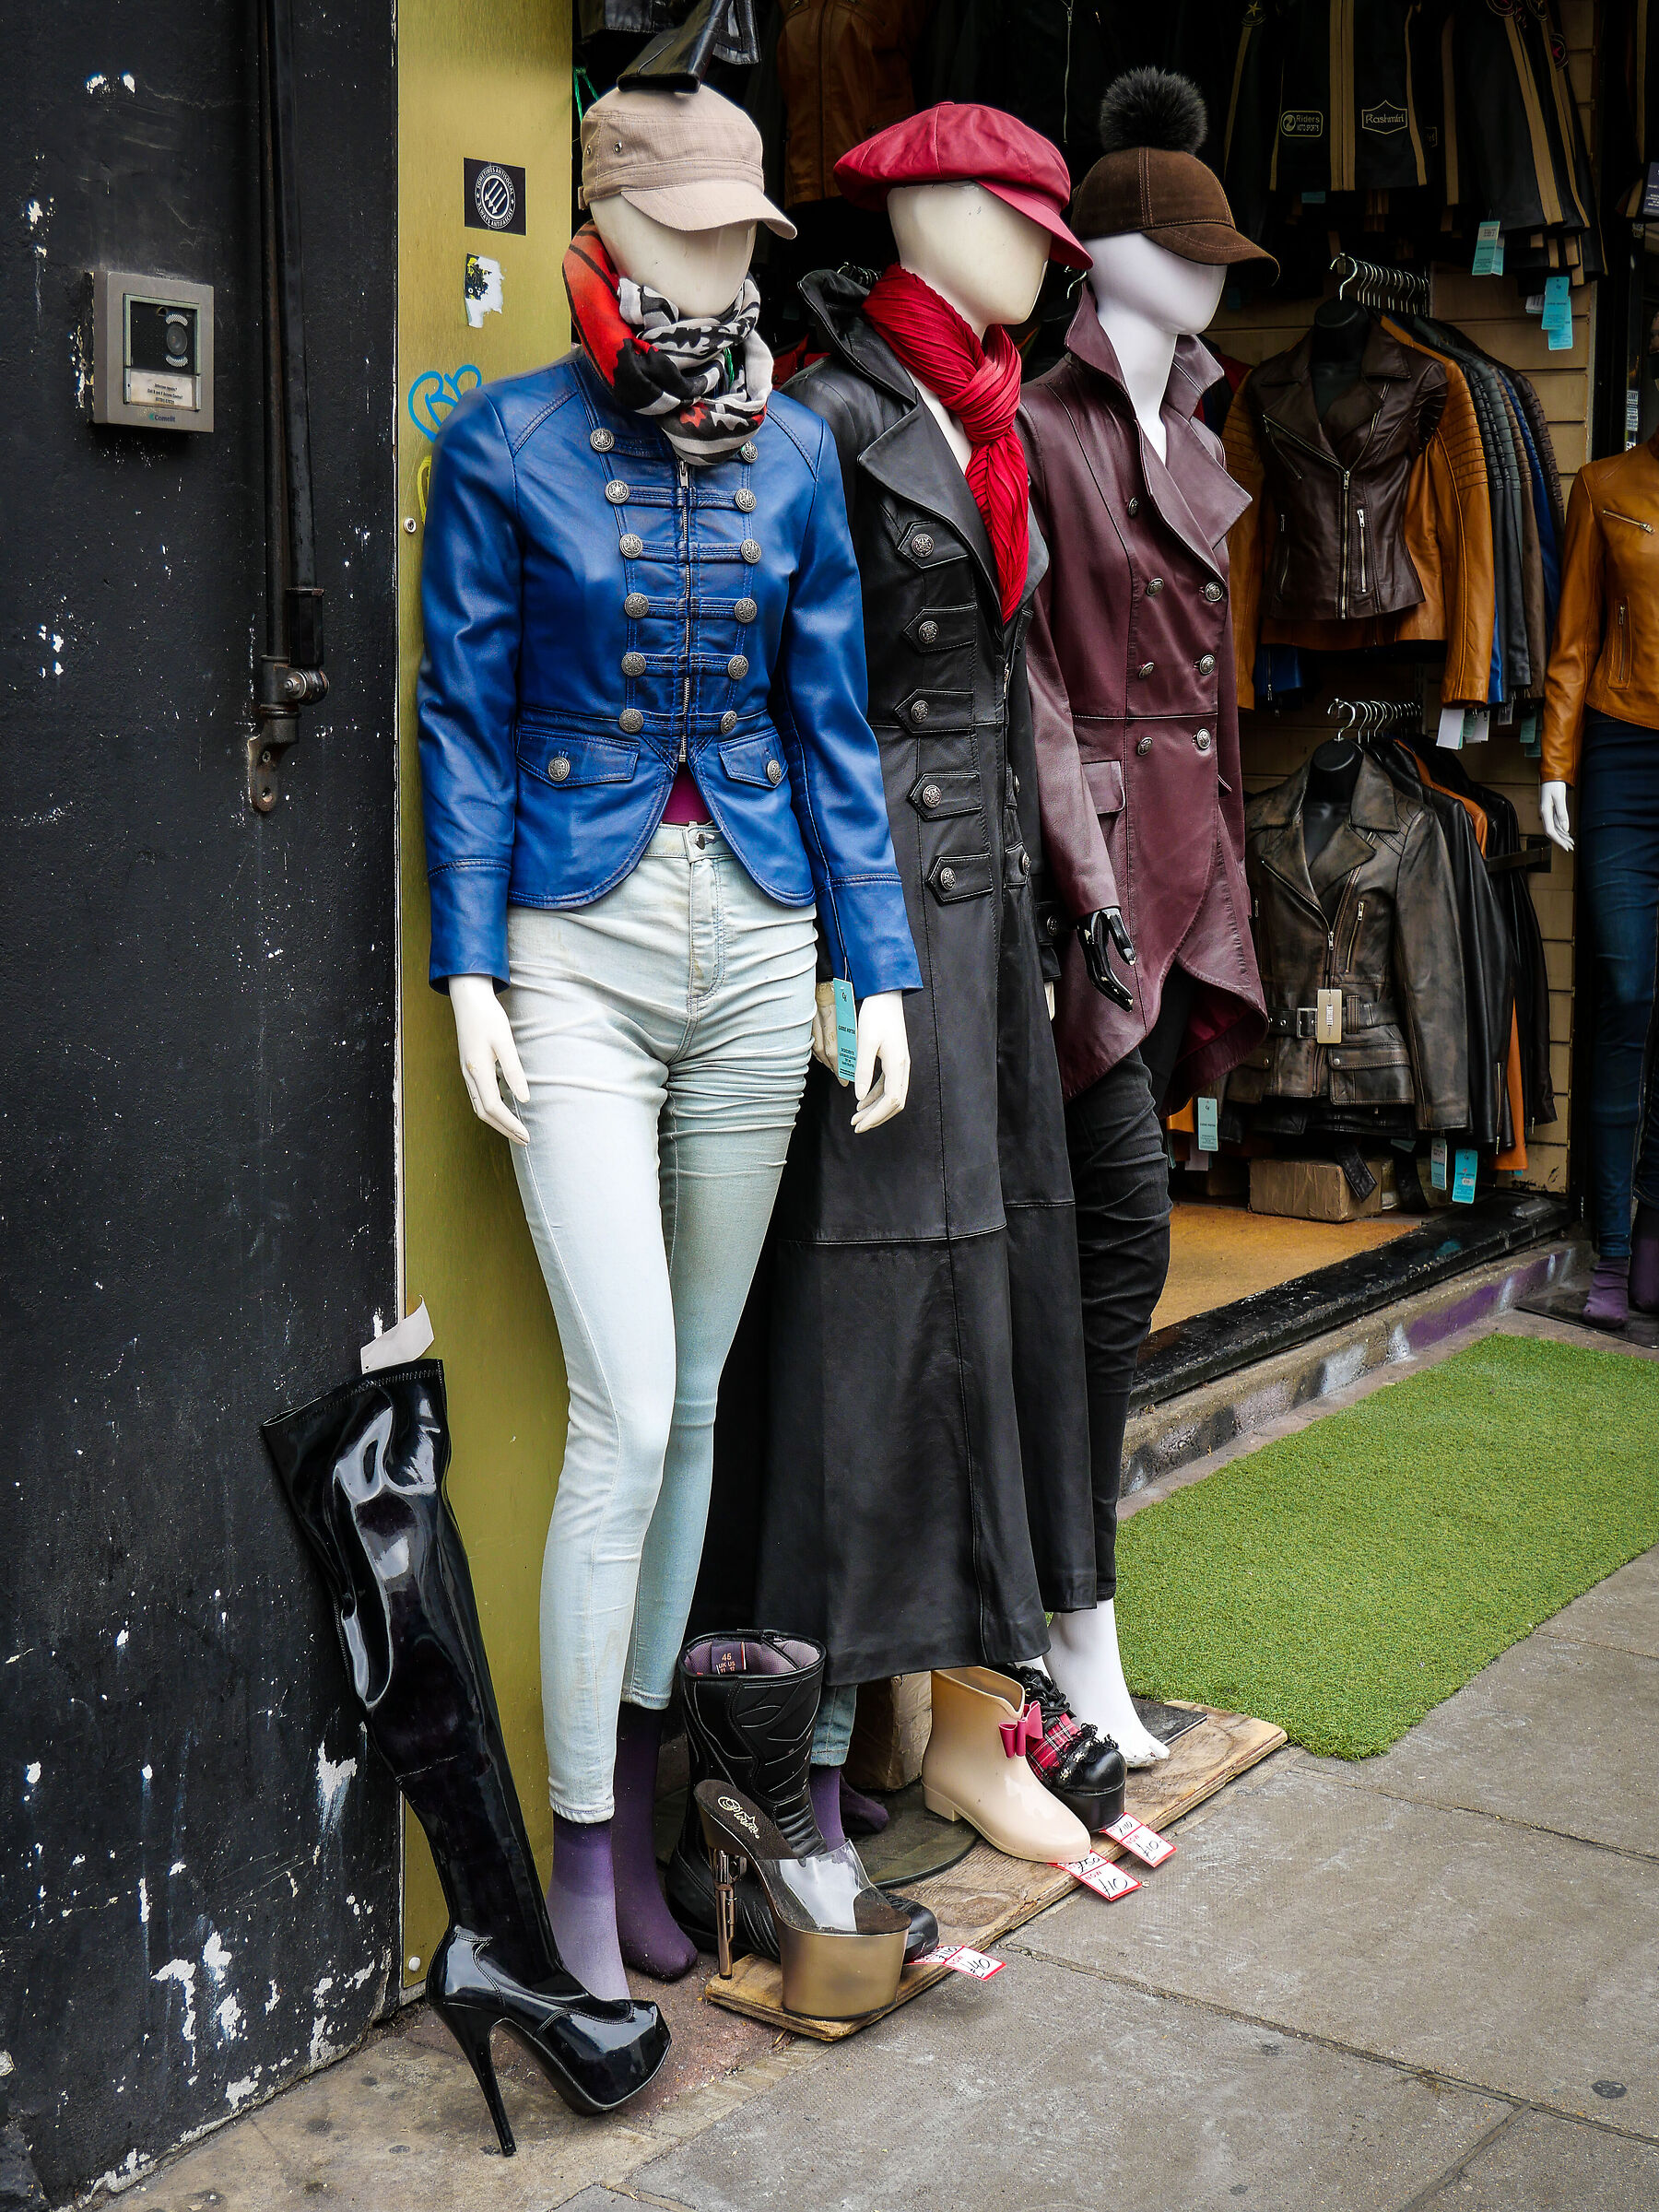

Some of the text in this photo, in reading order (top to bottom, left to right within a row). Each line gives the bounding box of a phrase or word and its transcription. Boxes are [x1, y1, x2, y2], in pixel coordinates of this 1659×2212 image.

[1296, 114, 1320, 123] Riders
[1126, 1834, 1140, 1844] NOW
[1085, 1870, 1102, 1880] NOW
[949, 1955, 964, 1965] NOW
